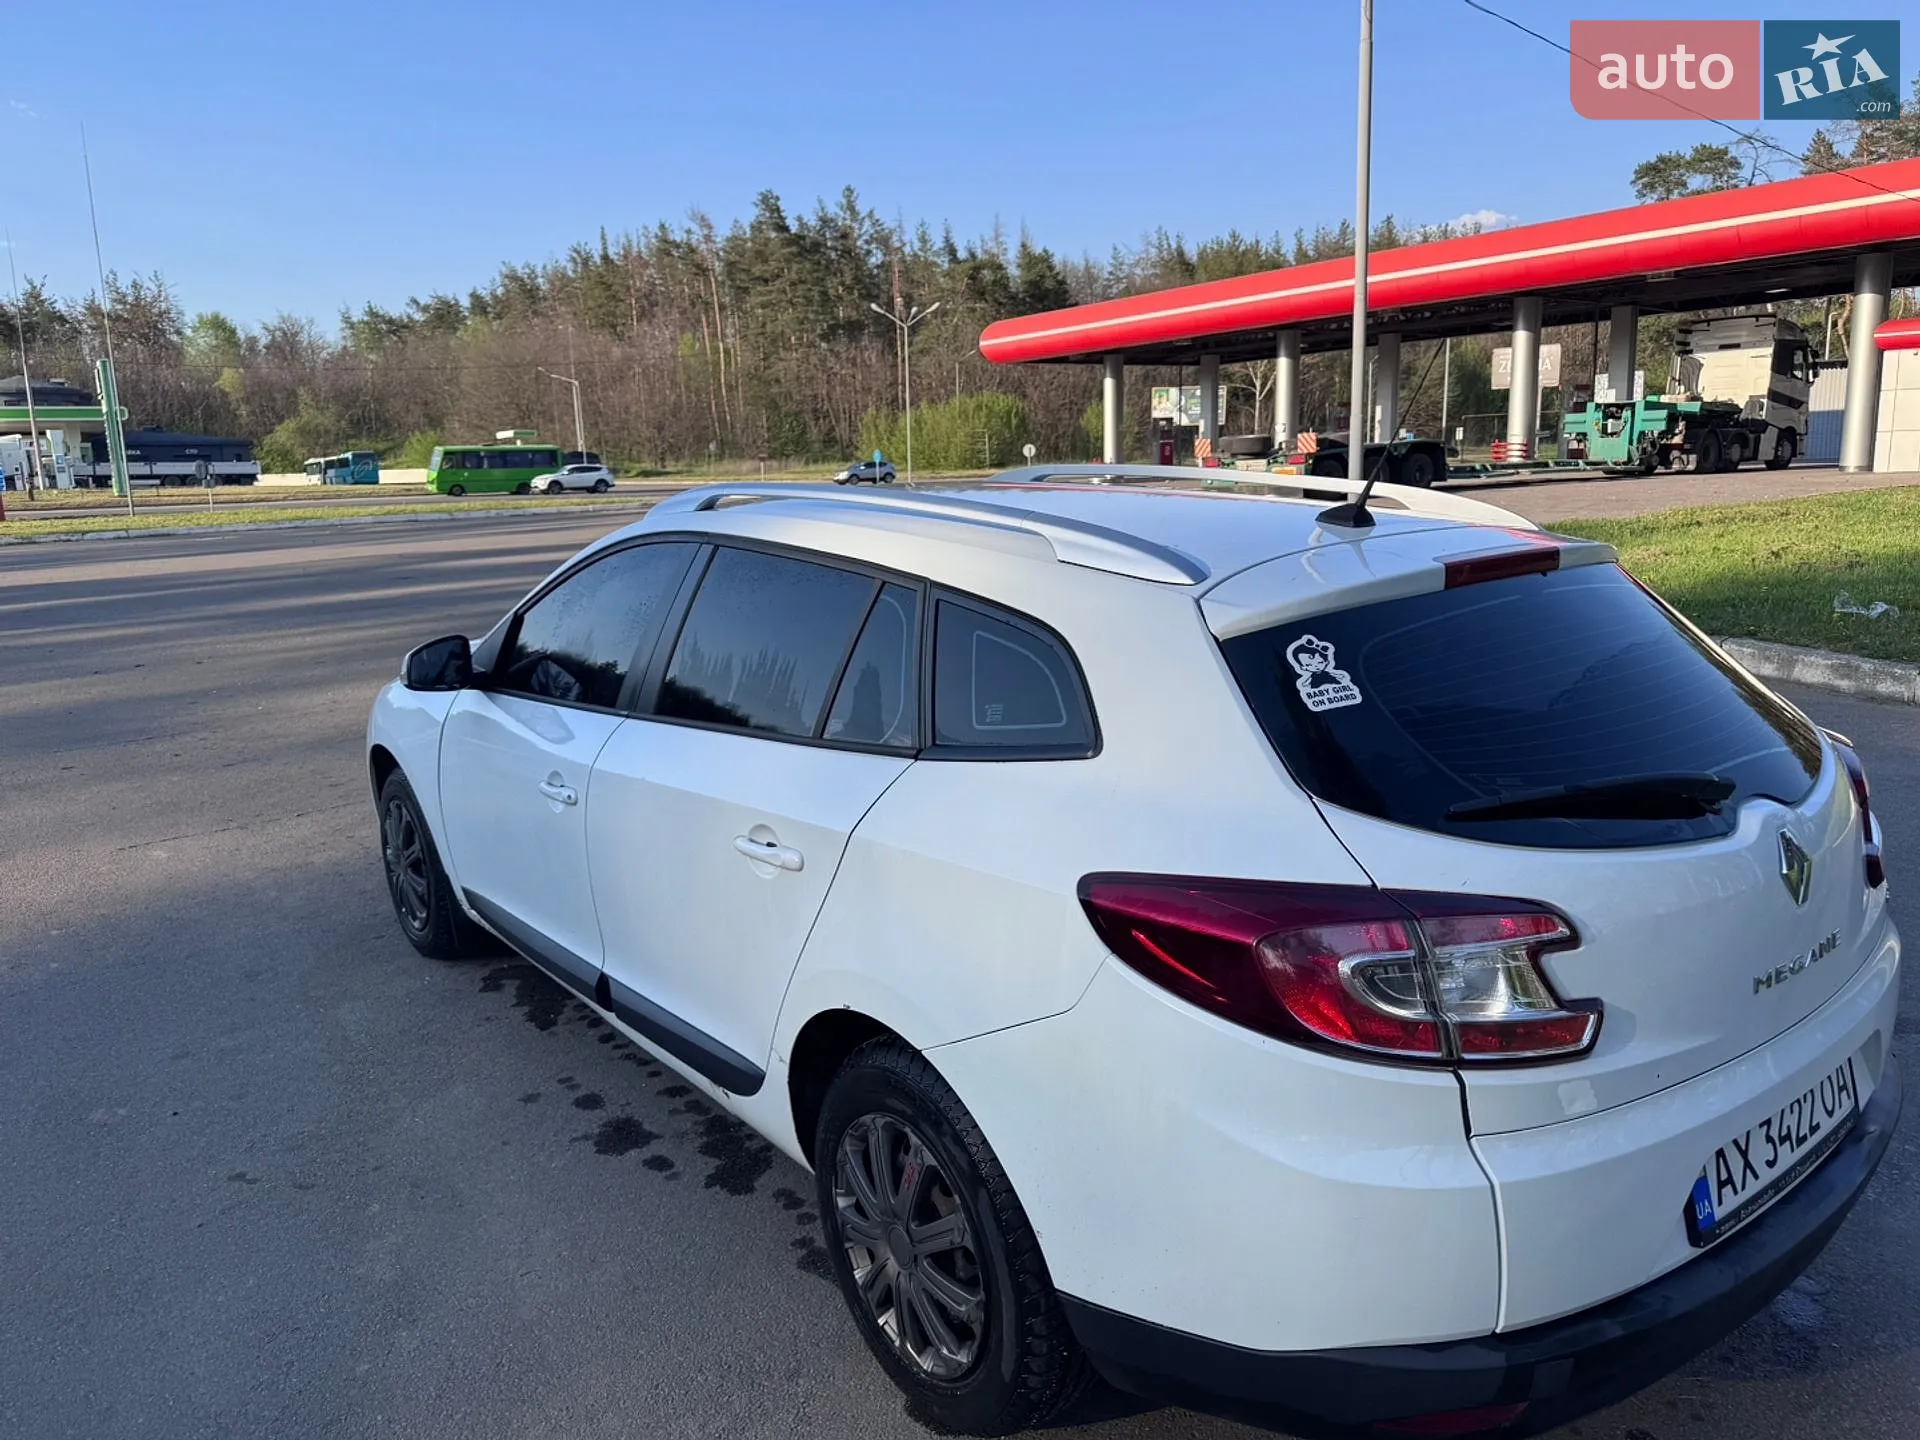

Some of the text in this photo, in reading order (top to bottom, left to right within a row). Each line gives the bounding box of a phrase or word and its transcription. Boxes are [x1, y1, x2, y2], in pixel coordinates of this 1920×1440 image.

[1305, 685, 1354, 700] BABY GIRL
[1312, 693, 1357, 708] ON BOARD
[1753, 928, 1841, 995] MEGANE
[1715, 1130, 1760, 1207] AX
[1759, 1089, 1821, 1170] 3422
[1695, 1199, 1712, 1219] UA
